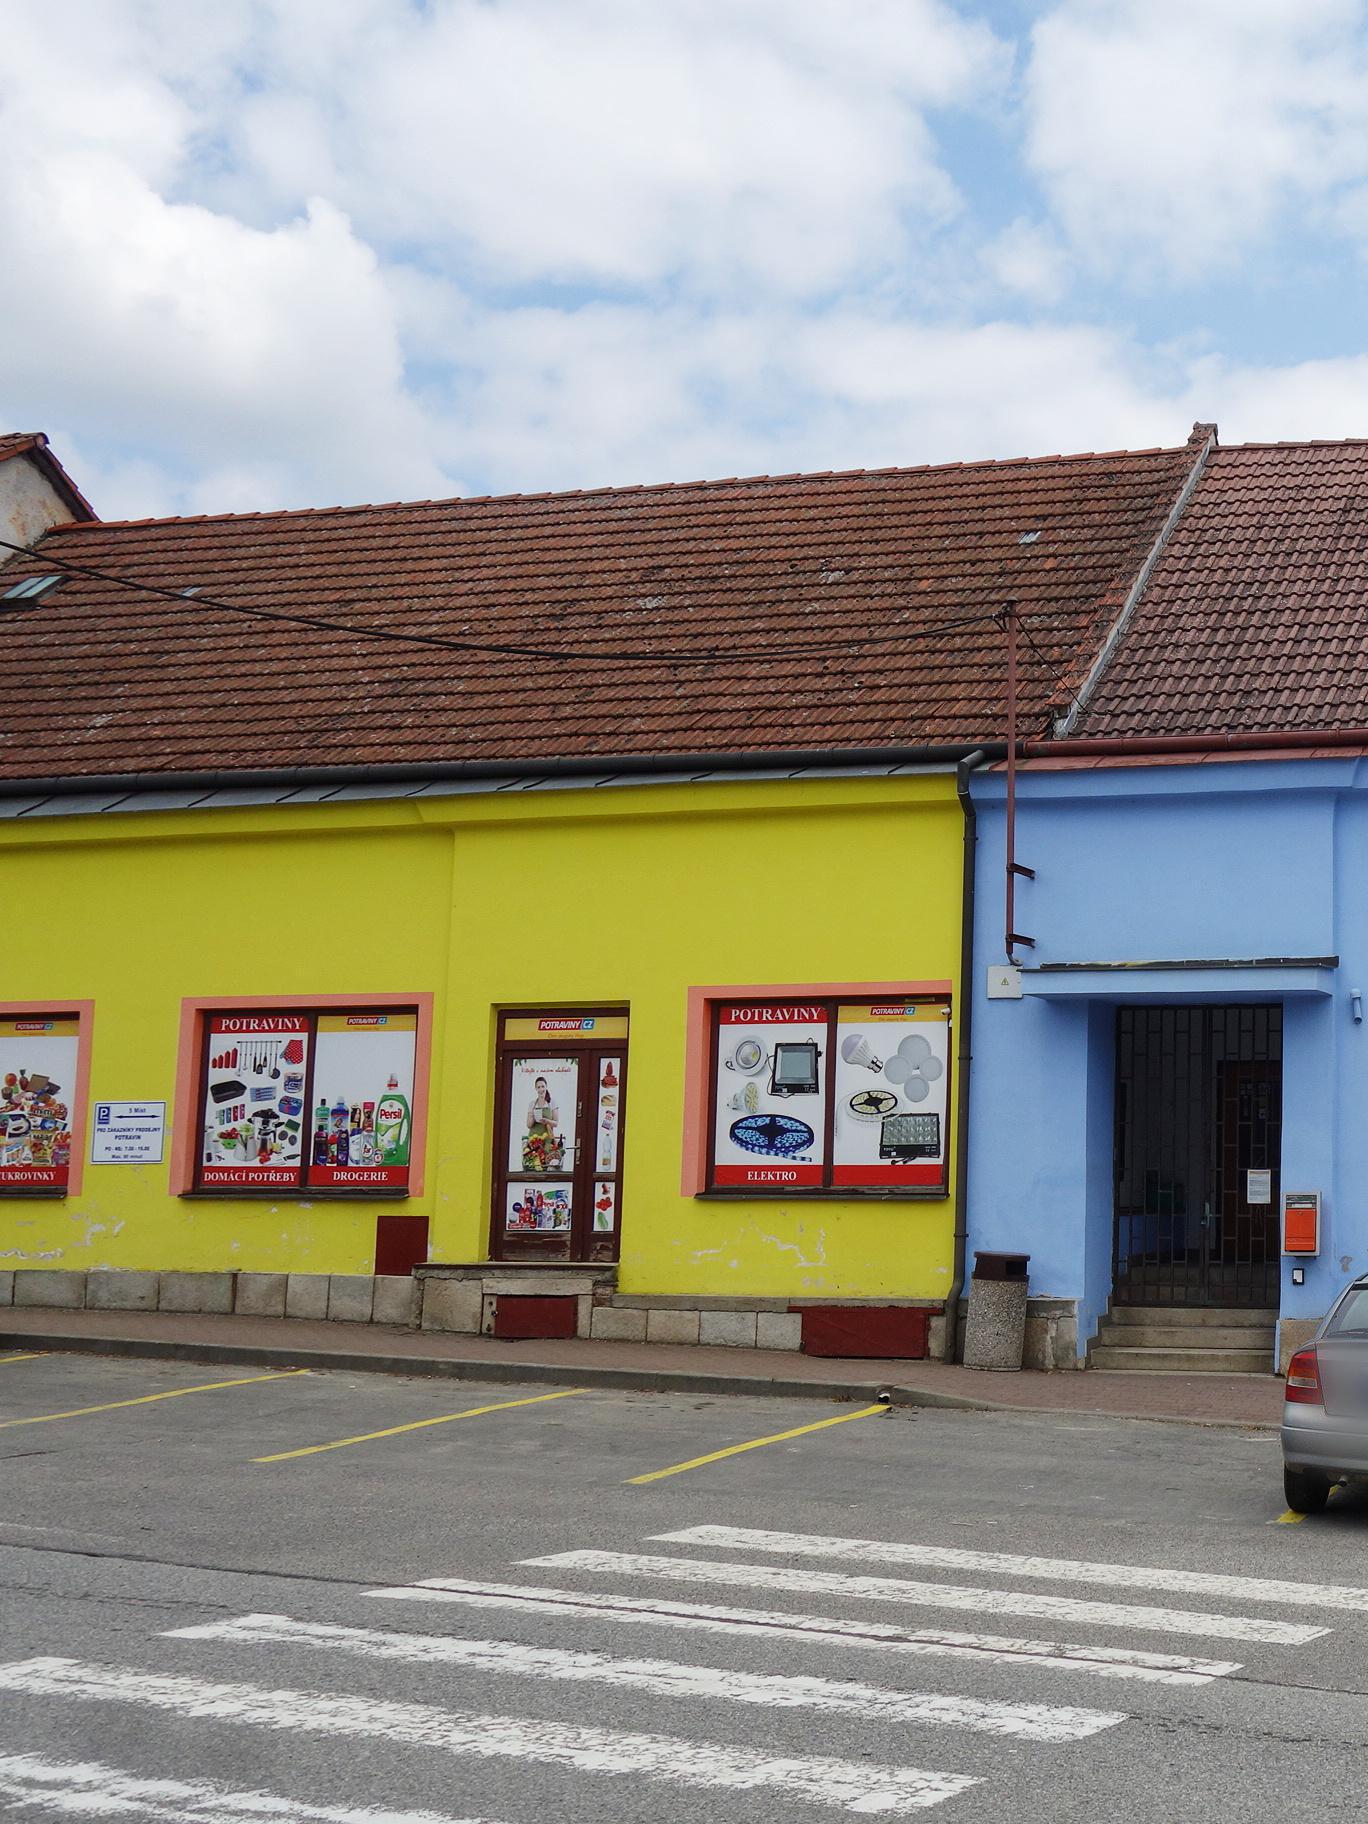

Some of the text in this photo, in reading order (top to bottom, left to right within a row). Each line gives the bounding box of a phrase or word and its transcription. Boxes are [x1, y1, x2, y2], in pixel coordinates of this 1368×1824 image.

[730, 1007, 820, 1022] POTRAVINY
[220, 1017, 304, 1031] POTRAVINY
[540, 1020, 593, 1029] POTRAVINY CZ
[379, 1108, 403, 1120] Persil
[0, 1171, 56, 1181] UKROVINKY
[204, 1170, 298, 1182] DOMÁCÍ POTŘEBY
[333, 1171, 389, 1182] DROGERIE
[746, 1171, 797, 1181] ELEKTRO
